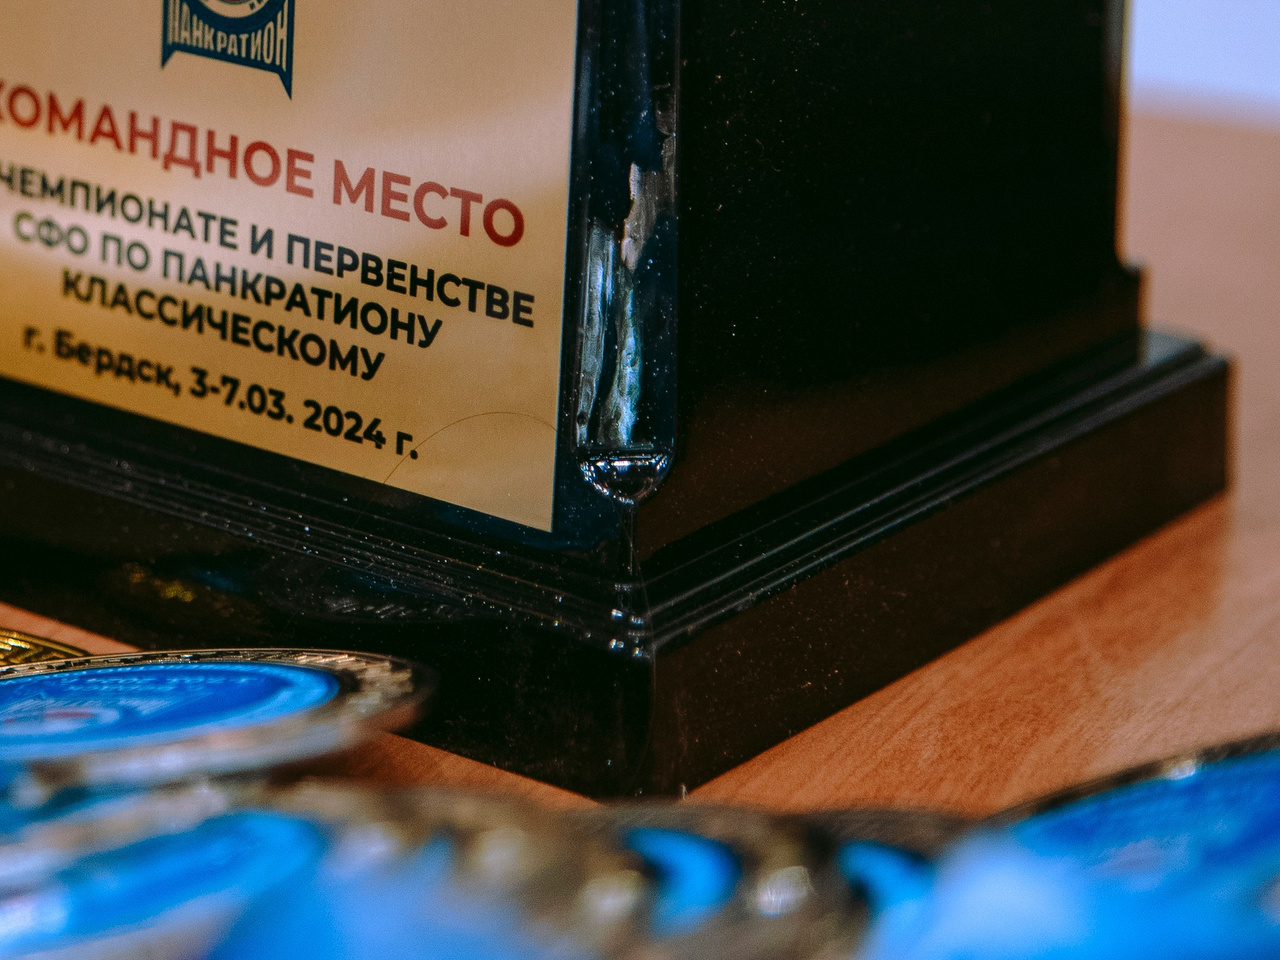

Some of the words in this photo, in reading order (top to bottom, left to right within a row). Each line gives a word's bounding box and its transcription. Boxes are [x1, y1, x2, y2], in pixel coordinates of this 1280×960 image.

[332, 159, 525, 248] МЕСТО
[13, 211, 89, 256] СФО
[101, 233, 151, 271] ПО
[163, 249, 443, 349] ПАНКРАТИОНУ
[61, 268, 386, 381] КЛАССИЧЕСКОМУ
[249, 224, 274, 260] И
[286, 233, 535, 328] ПЕРВЕНСТВЕ
[21, 325, 46, 354] г.
[55, 329, 181, 397] Бердск,
[190, 366, 295, 425] 3-7.03.
[303, 400, 387, 449] 2024
[395, 431, 420, 461] г.
